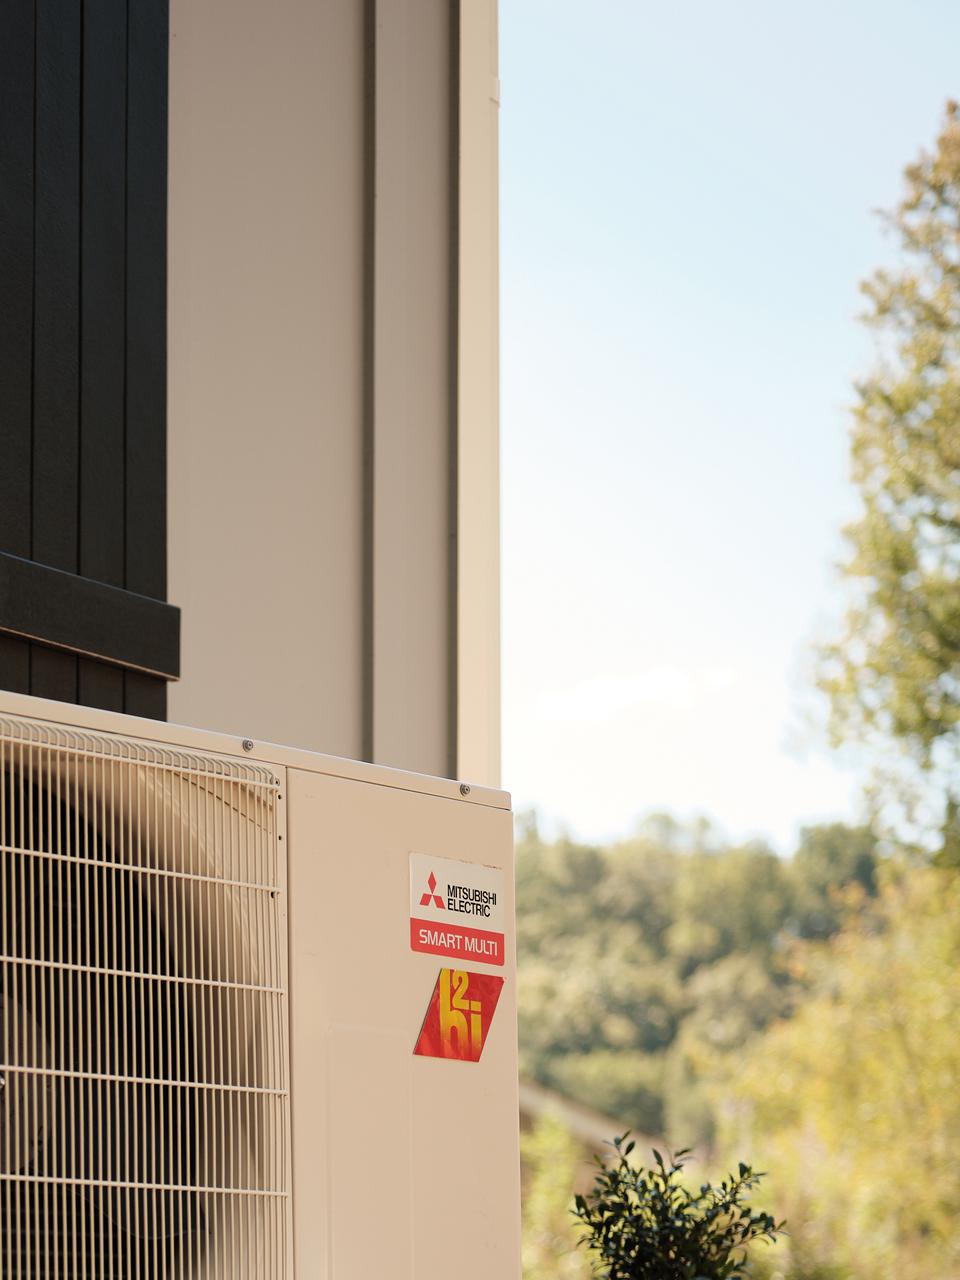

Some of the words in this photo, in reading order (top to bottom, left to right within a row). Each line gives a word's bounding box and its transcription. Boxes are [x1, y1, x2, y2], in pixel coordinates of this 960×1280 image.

[447, 884, 497, 905] MITSUBISHI
[447, 898, 491, 918] ELECTRIC
[419, 929, 463, 951] SMART
[464, 937, 498, 957] MULTI
